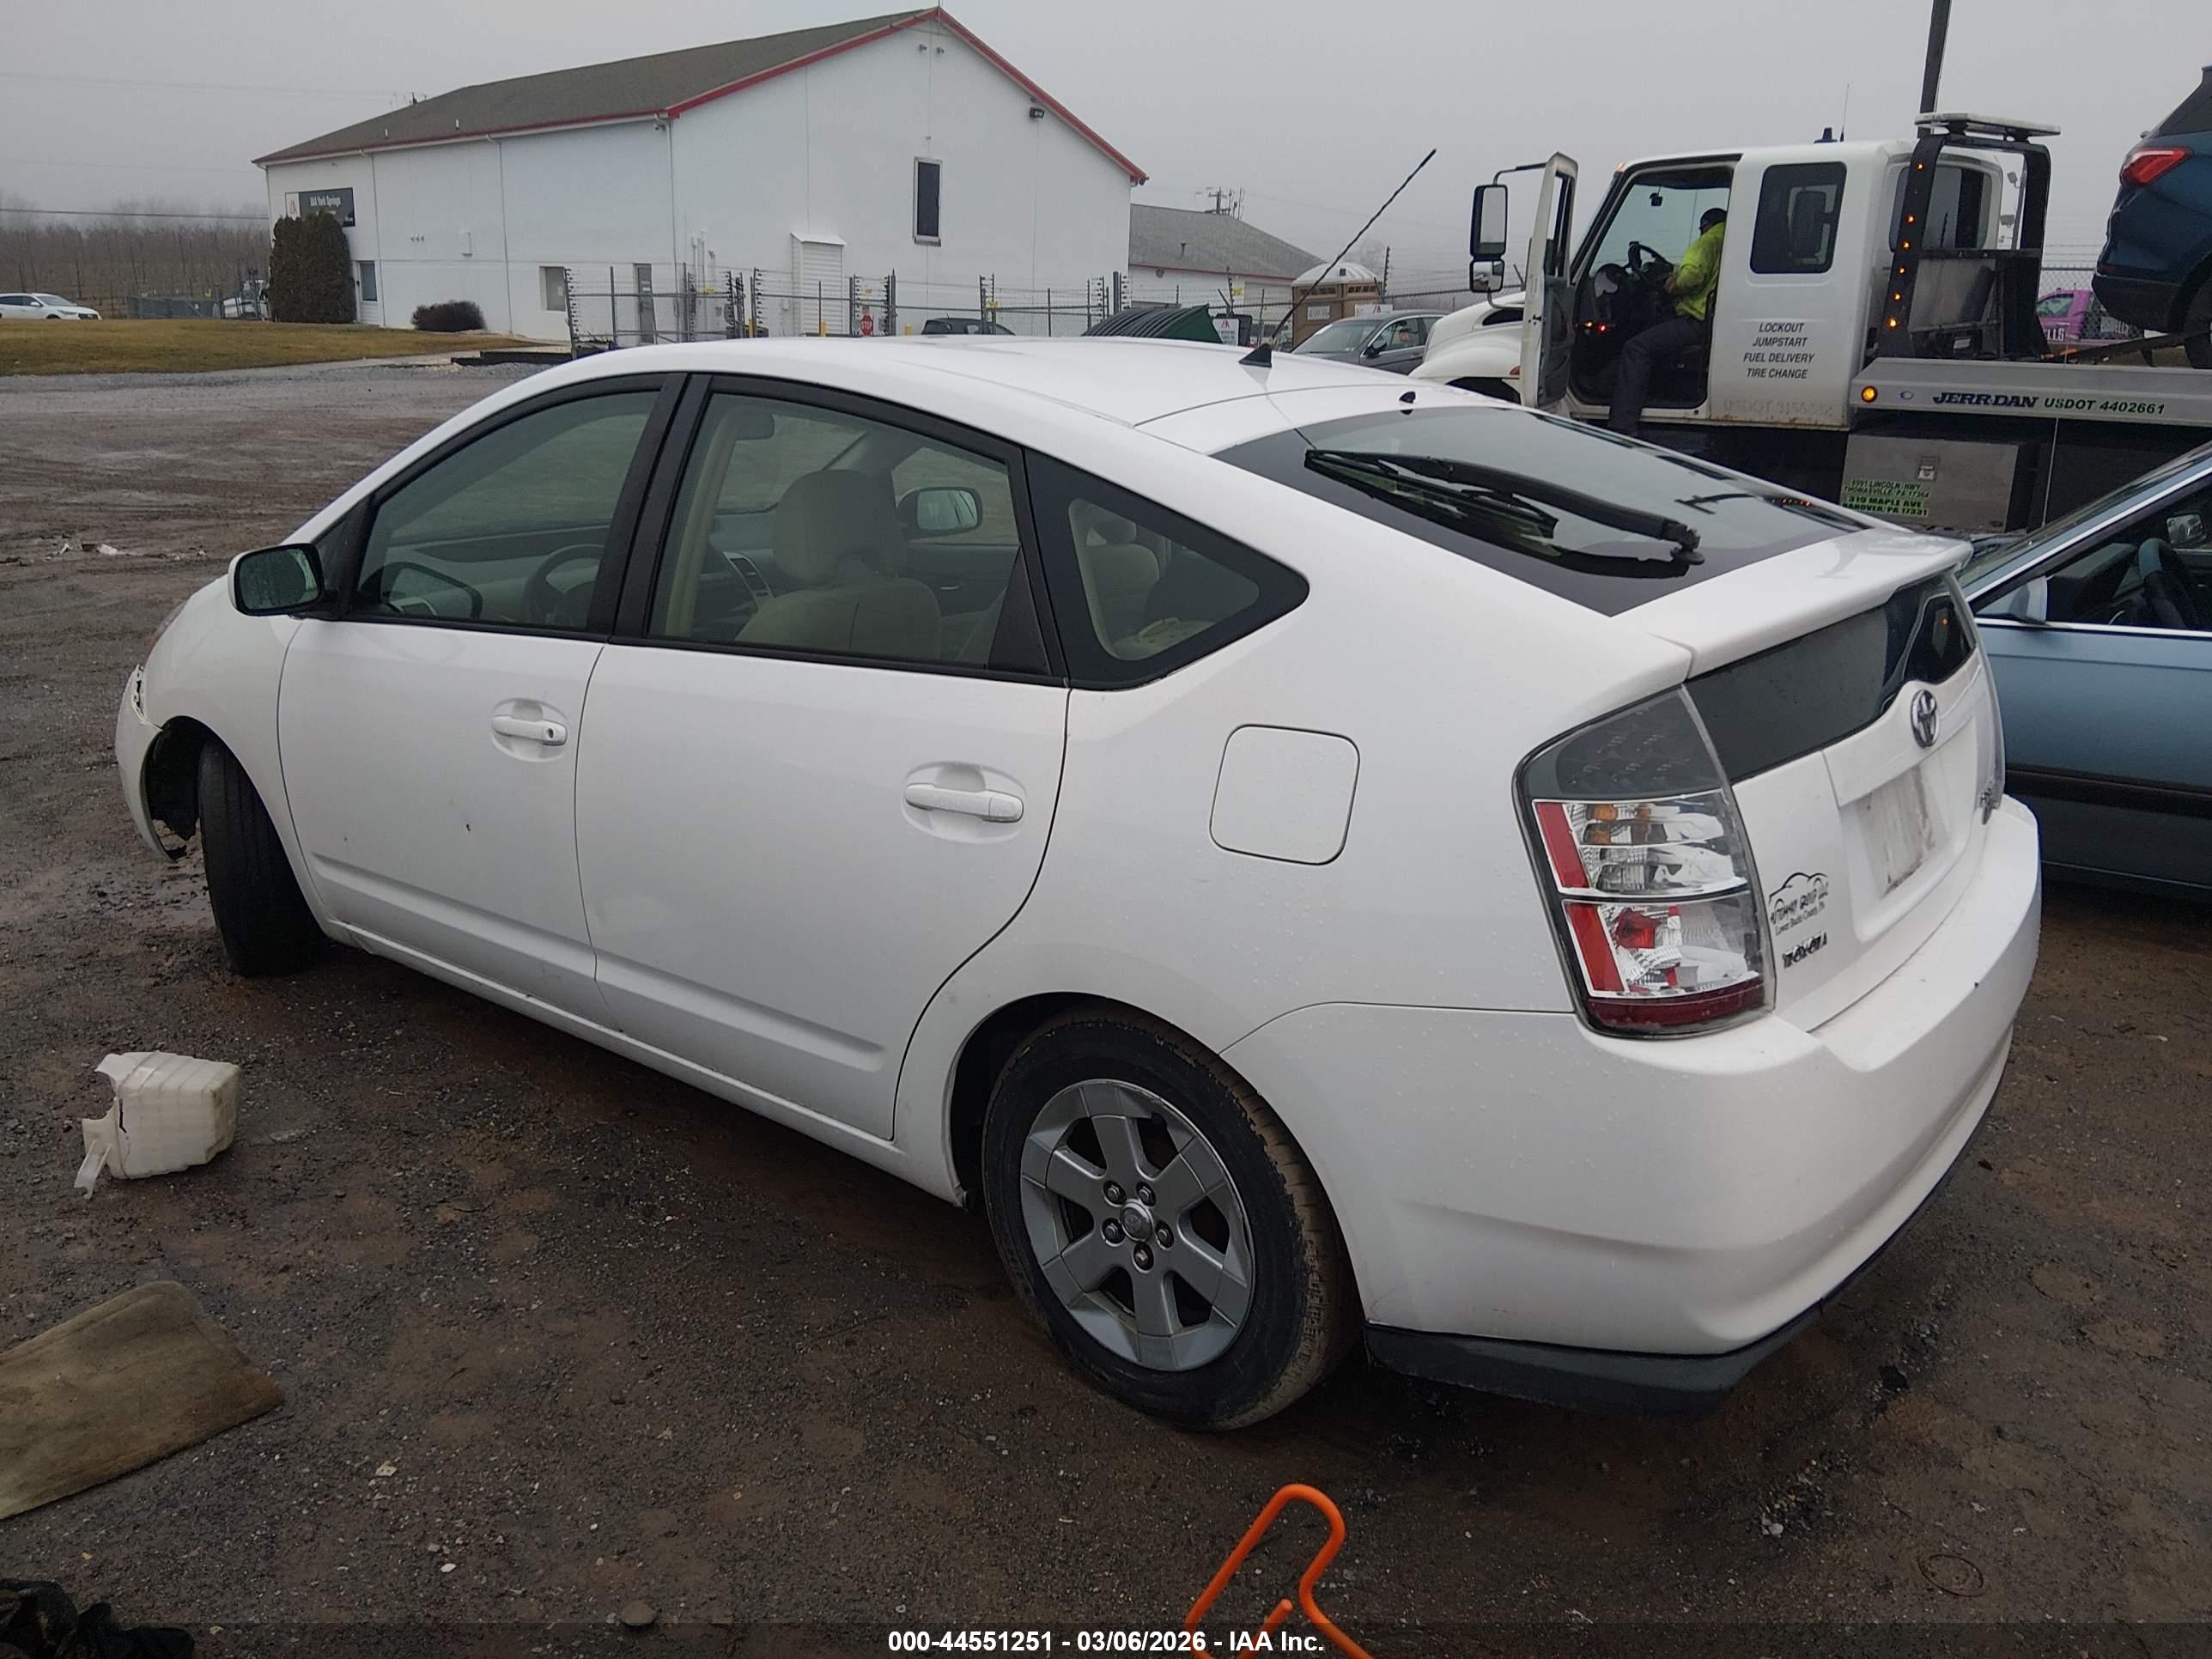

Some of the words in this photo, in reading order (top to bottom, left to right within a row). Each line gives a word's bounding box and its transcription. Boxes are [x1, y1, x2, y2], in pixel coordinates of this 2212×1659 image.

[1759, 323, 1805, 333] LOCKOUT
[1753, 337, 1808, 347] JUMPSTART
[1743, 352, 1766, 362] FUEL
[1768, 353, 1815, 363] DELIVERY
[1747, 368, 1767, 378] TIRE
[1769, 368, 1808, 379] CHANGE
[2044, 398, 2096, 410] USDOT
[2100, 400, 2166, 415] 4402661
[1869, 498, 1900, 507] MAPLE
